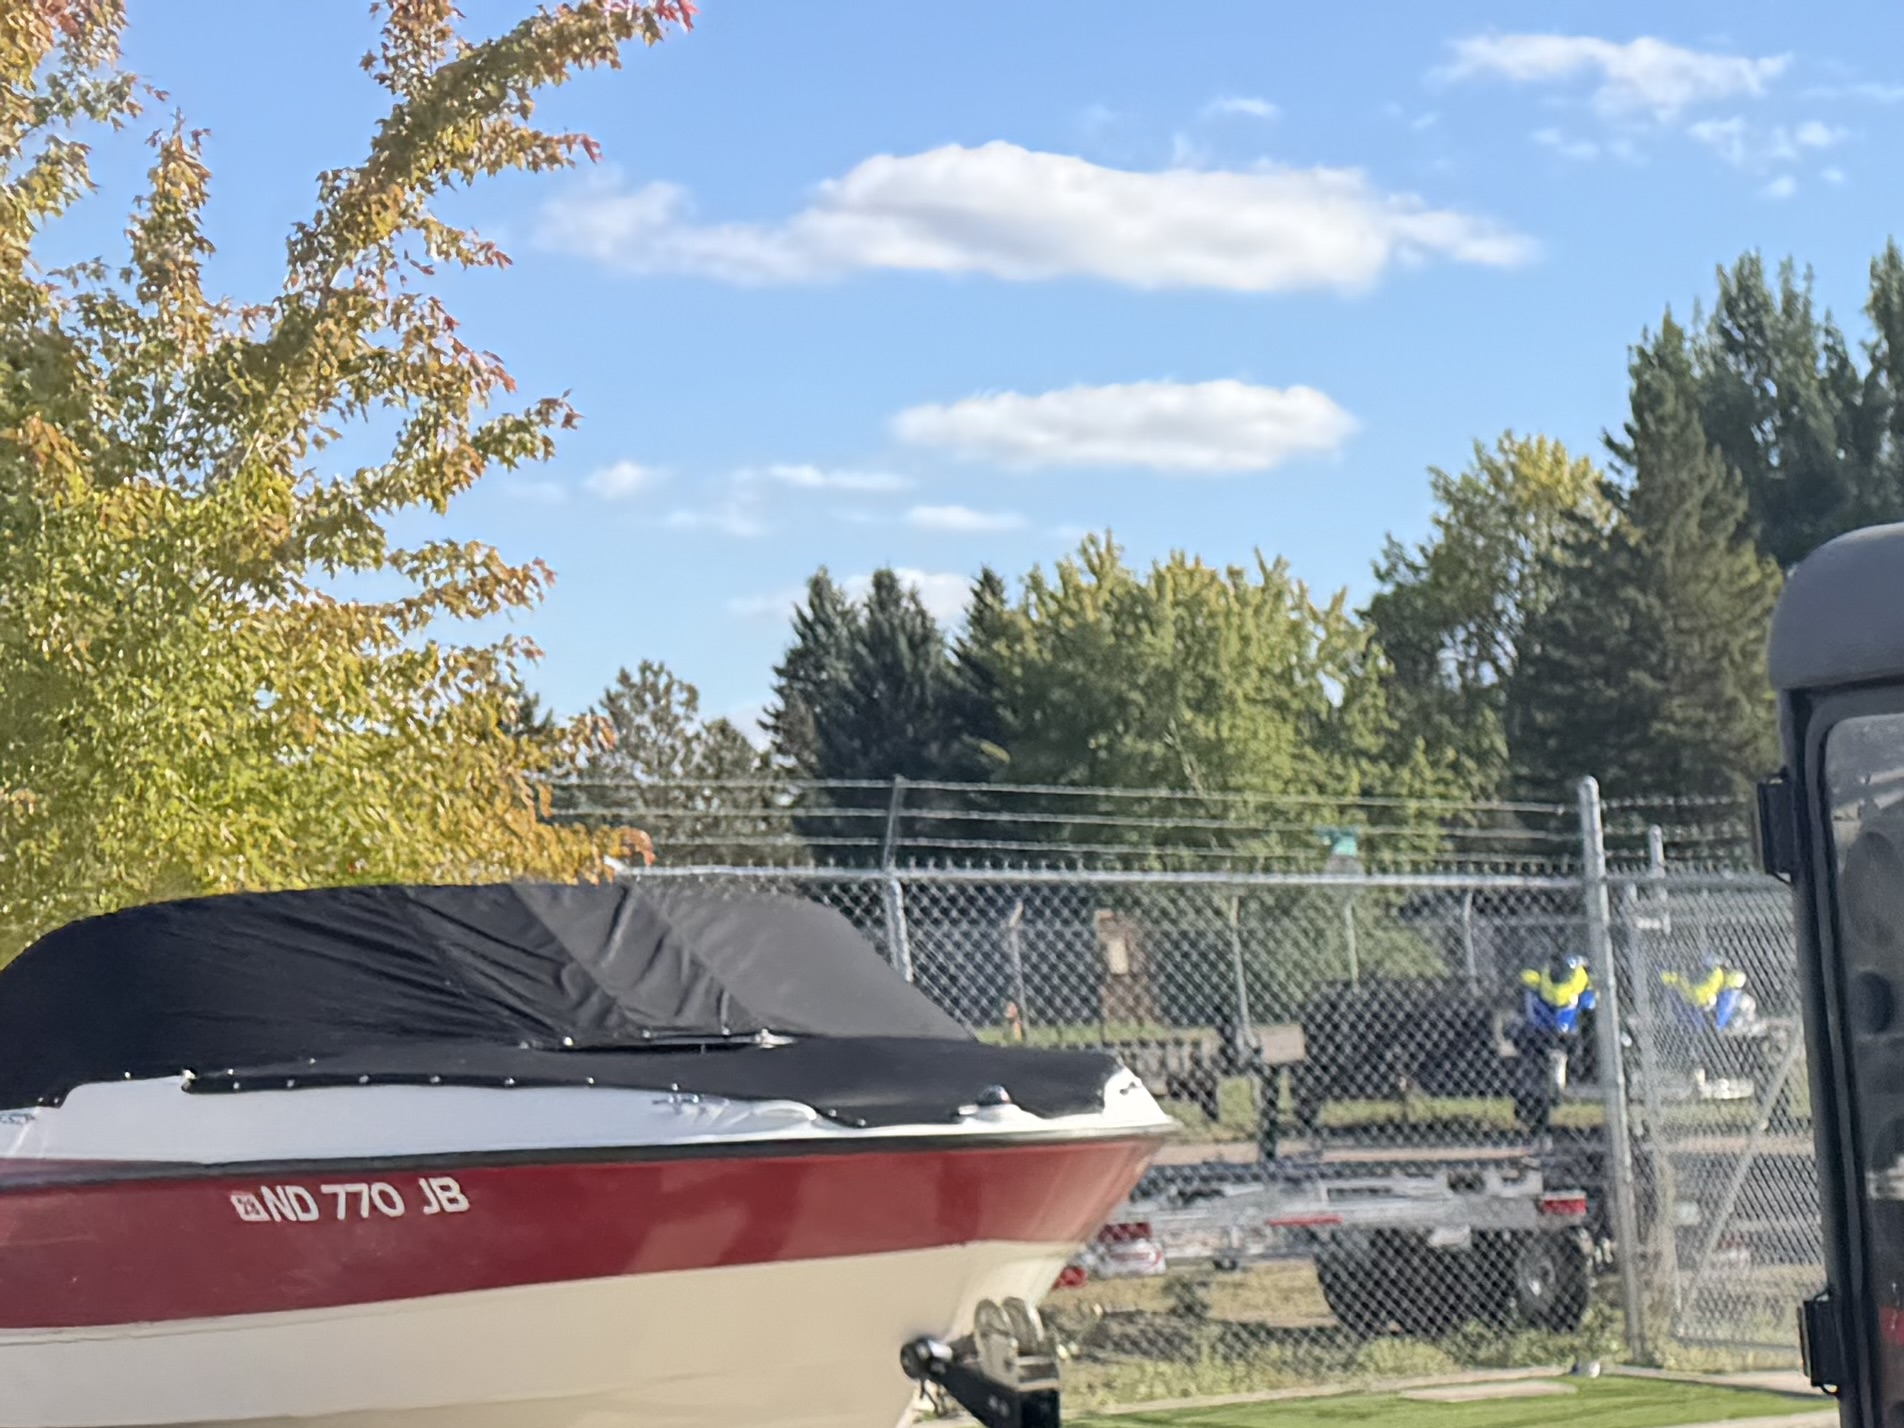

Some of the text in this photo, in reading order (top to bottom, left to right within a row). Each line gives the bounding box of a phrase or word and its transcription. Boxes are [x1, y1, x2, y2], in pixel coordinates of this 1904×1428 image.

[261, 1177, 470, 1222] ND 770 JB
